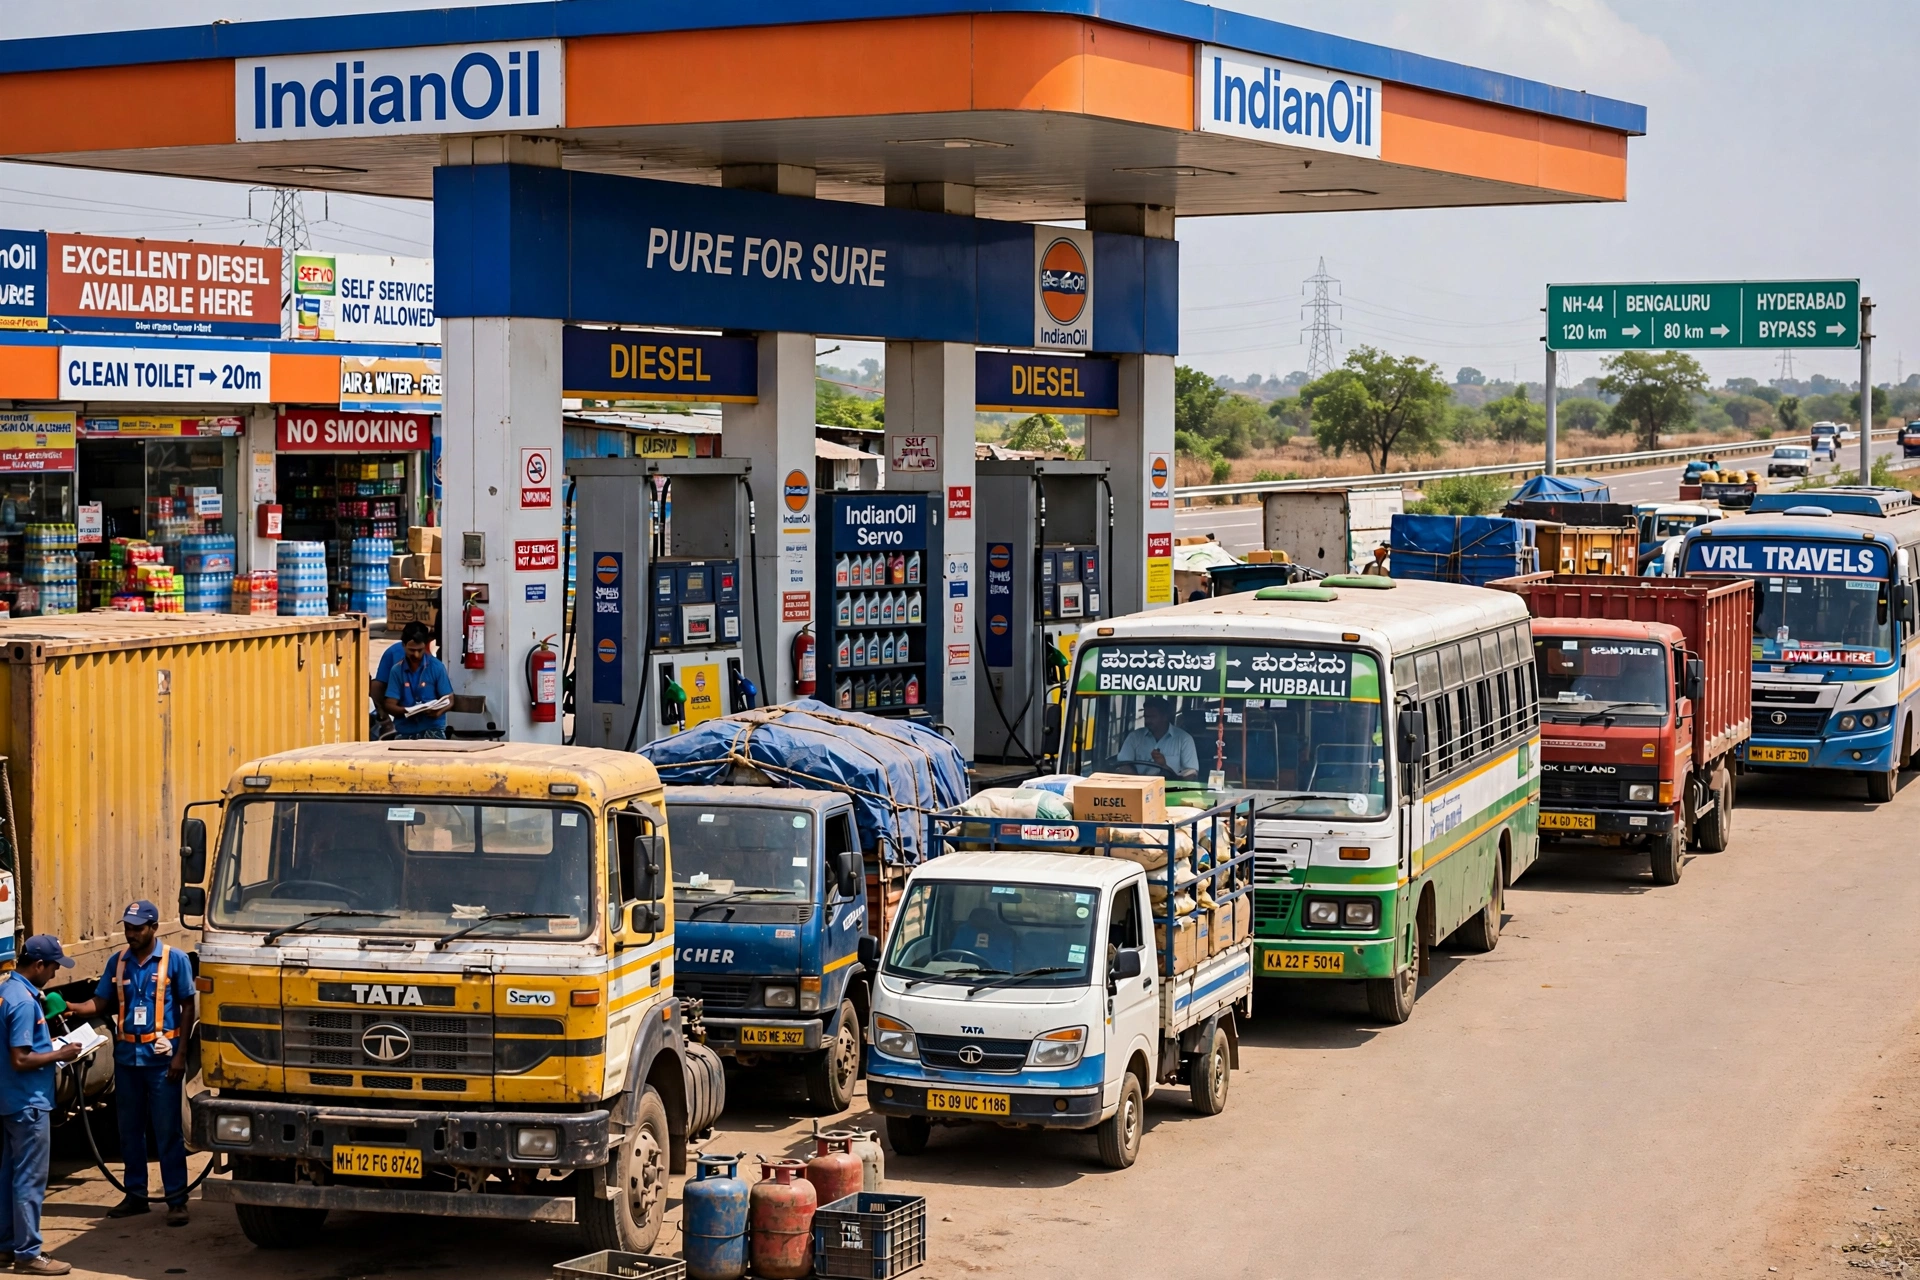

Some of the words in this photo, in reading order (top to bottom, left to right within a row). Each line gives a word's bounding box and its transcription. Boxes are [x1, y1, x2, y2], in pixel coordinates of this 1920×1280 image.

[254, 50, 540, 130] IndianOil
[1213, 56, 1372, 146] IndianOil
[62, 245, 191, 280] EXCELLENT
[197, 253, 270, 285] DIESEL
[647, 227, 735, 275] PURE
[742, 236, 803, 281] FOR
[811, 243, 887, 287] SURE
[79, 281, 194, 314] AVAILABLE
[200, 288, 253, 317] HERE
[341, 278, 375, 300] SELF
[379, 280, 433, 303] SERVICE
[1562, 295, 1604, 313] NH-44
[1626, 294, 1711, 312] BENGALURU
[1757, 292, 1846, 311] HYDERABAD
[342, 303, 370, 324] NOT
[373, 305, 435, 327] ALLOWED
[1040, 327, 1087, 345] IndianOil
[1562, 324, 1584, 340] 120
[1588, 324, 1607, 340] km
[1664, 322, 1681, 339] 80
[1684, 322, 1704, 339] km
[1758, 320, 1817, 339] BYPASS
[610, 343, 711, 382] DIESEL
[68, 360, 129, 387] CLEAN
[134, 362, 195, 388] TOILET
[222, 364, 261, 390] 20m
[342, 372, 363, 393] AIR
[363, 372, 373, 394] &
[375, 371, 413, 395] WATER
[1011, 365, 1085, 398] DIESEL
[287, 419, 318, 443] NO
[324, 419, 418, 443] SMOKING
[846, 504, 916, 525] IndianOil
[857, 527, 903, 545] Servo
[1701, 545, 1752, 569] VRL
[1762, 546, 1874, 574] TRAVELS
[1845, 651, 1873, 663] HERE
[1100, 673, 1202, 692] BENGALURU
[1259, 677, 1346, 697] HUBBALLI
[1563, 764, 1616, 774] LEYLAND
[1093, 797, 1127, 807] DIESEL
[1266, 953, 1284, 971] KA
[1286, 953, 1299, 971] 22
[1302, 954, 1311, 971] F
[1313, 954, 1341, 973] 5014
[351, 984, 424, 1006] TATA
[509, 990, 551, 1004] Servo
[743, 1029, 755, 1042] KA
[960, 1025, 985, 1035] TATA
[931, 1093, 946, 1108] TS
[948, 1095, 961, 1109] 09
[964, 1096, 979, 1111] UC
[982, 1097, 1007, 1112] 1186
[336, 1152, 353, 1170] MH
[356, 1153, 369, 1171] 12
[372, 1154, 388, 1173] FG
[391, 1155, 420, 1174] 8742
